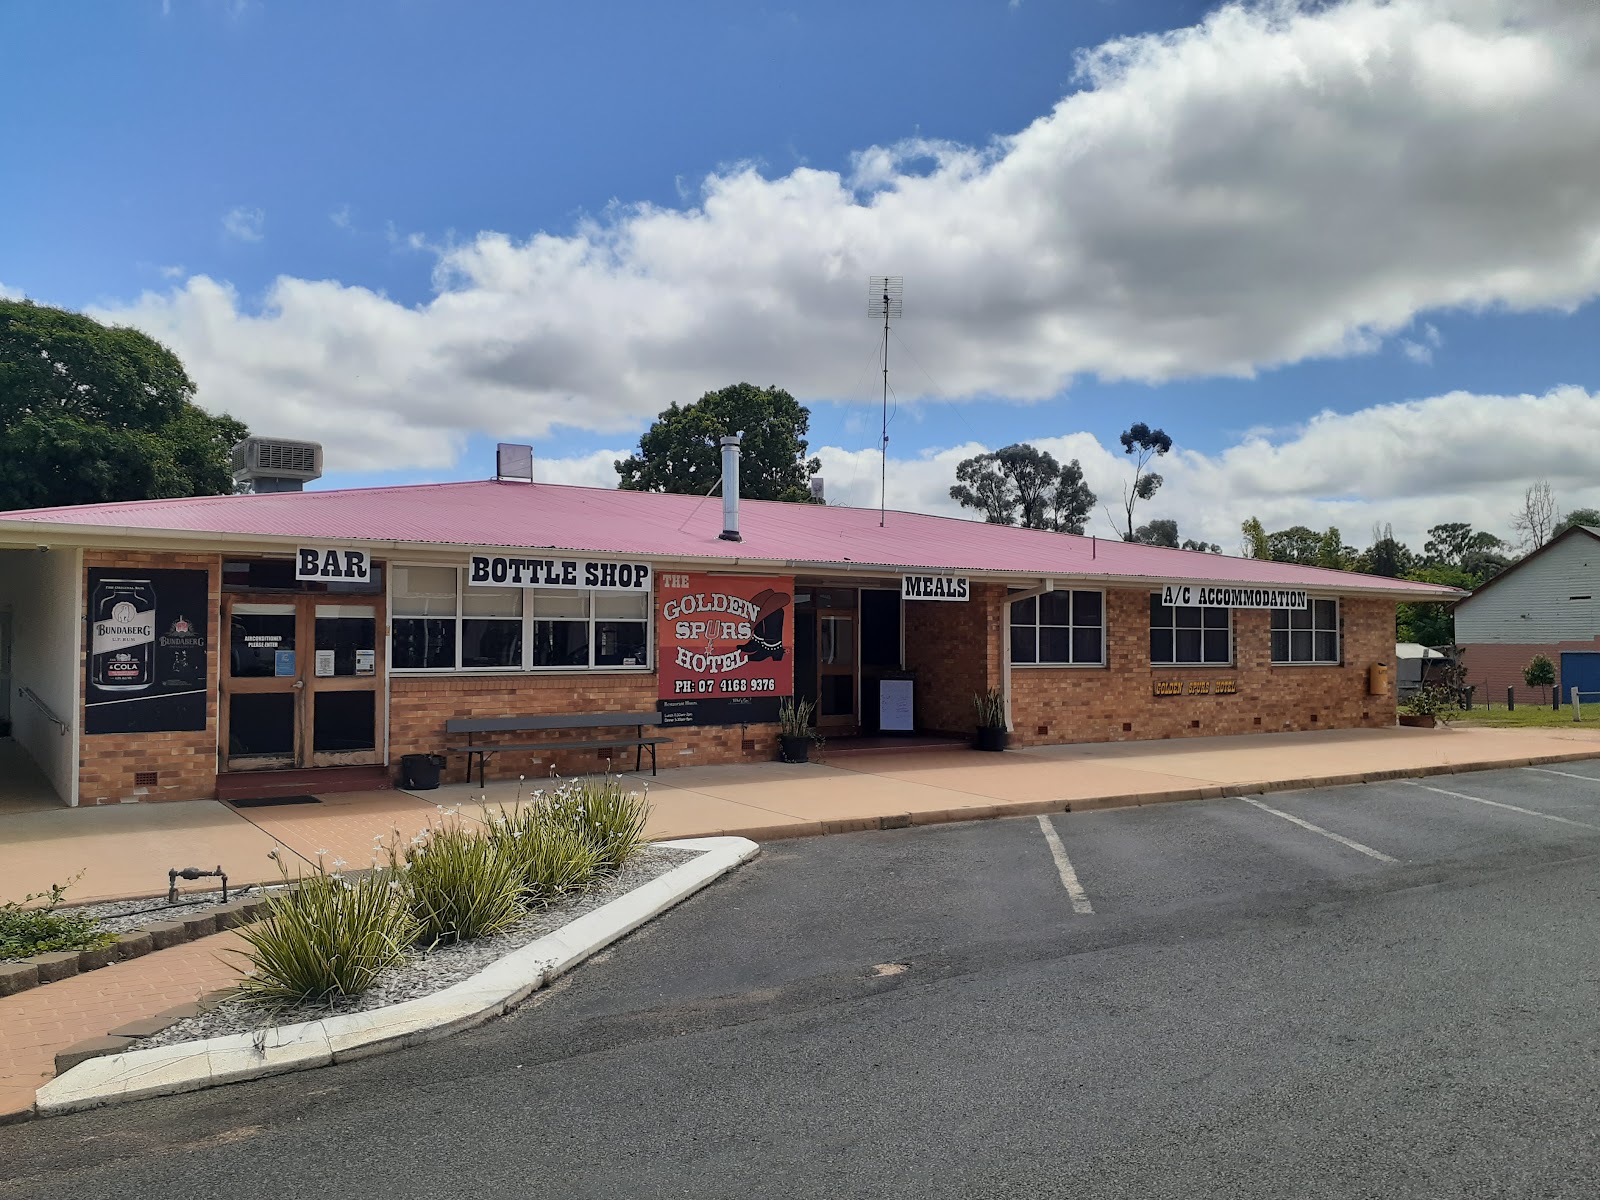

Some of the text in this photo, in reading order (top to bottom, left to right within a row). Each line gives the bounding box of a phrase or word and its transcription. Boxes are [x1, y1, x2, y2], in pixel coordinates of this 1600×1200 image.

[299, 549, 367, 579] BAR
[472, 556, 649, 588] BOTTLE SHOP
[662, 574, 690, 589] THE
[905, 576, 967, 598] MEALS
[1163, 586, 1306, 608] A/C ACCOMMODATION
[663, 593, 761, 623] GOLDEN
[96, 624, 151, 637] BUNDABERG
[675, 619, 752, 640] SPURS
[159, 636, 204, 647] BUNDABERG
[675, 646, 749, 674] HOTEL
[674, 678, 775, 693] PH: 07 4168 9376
[1156, 680, 1237, 695] GOLDEN SPURS HOTEL
